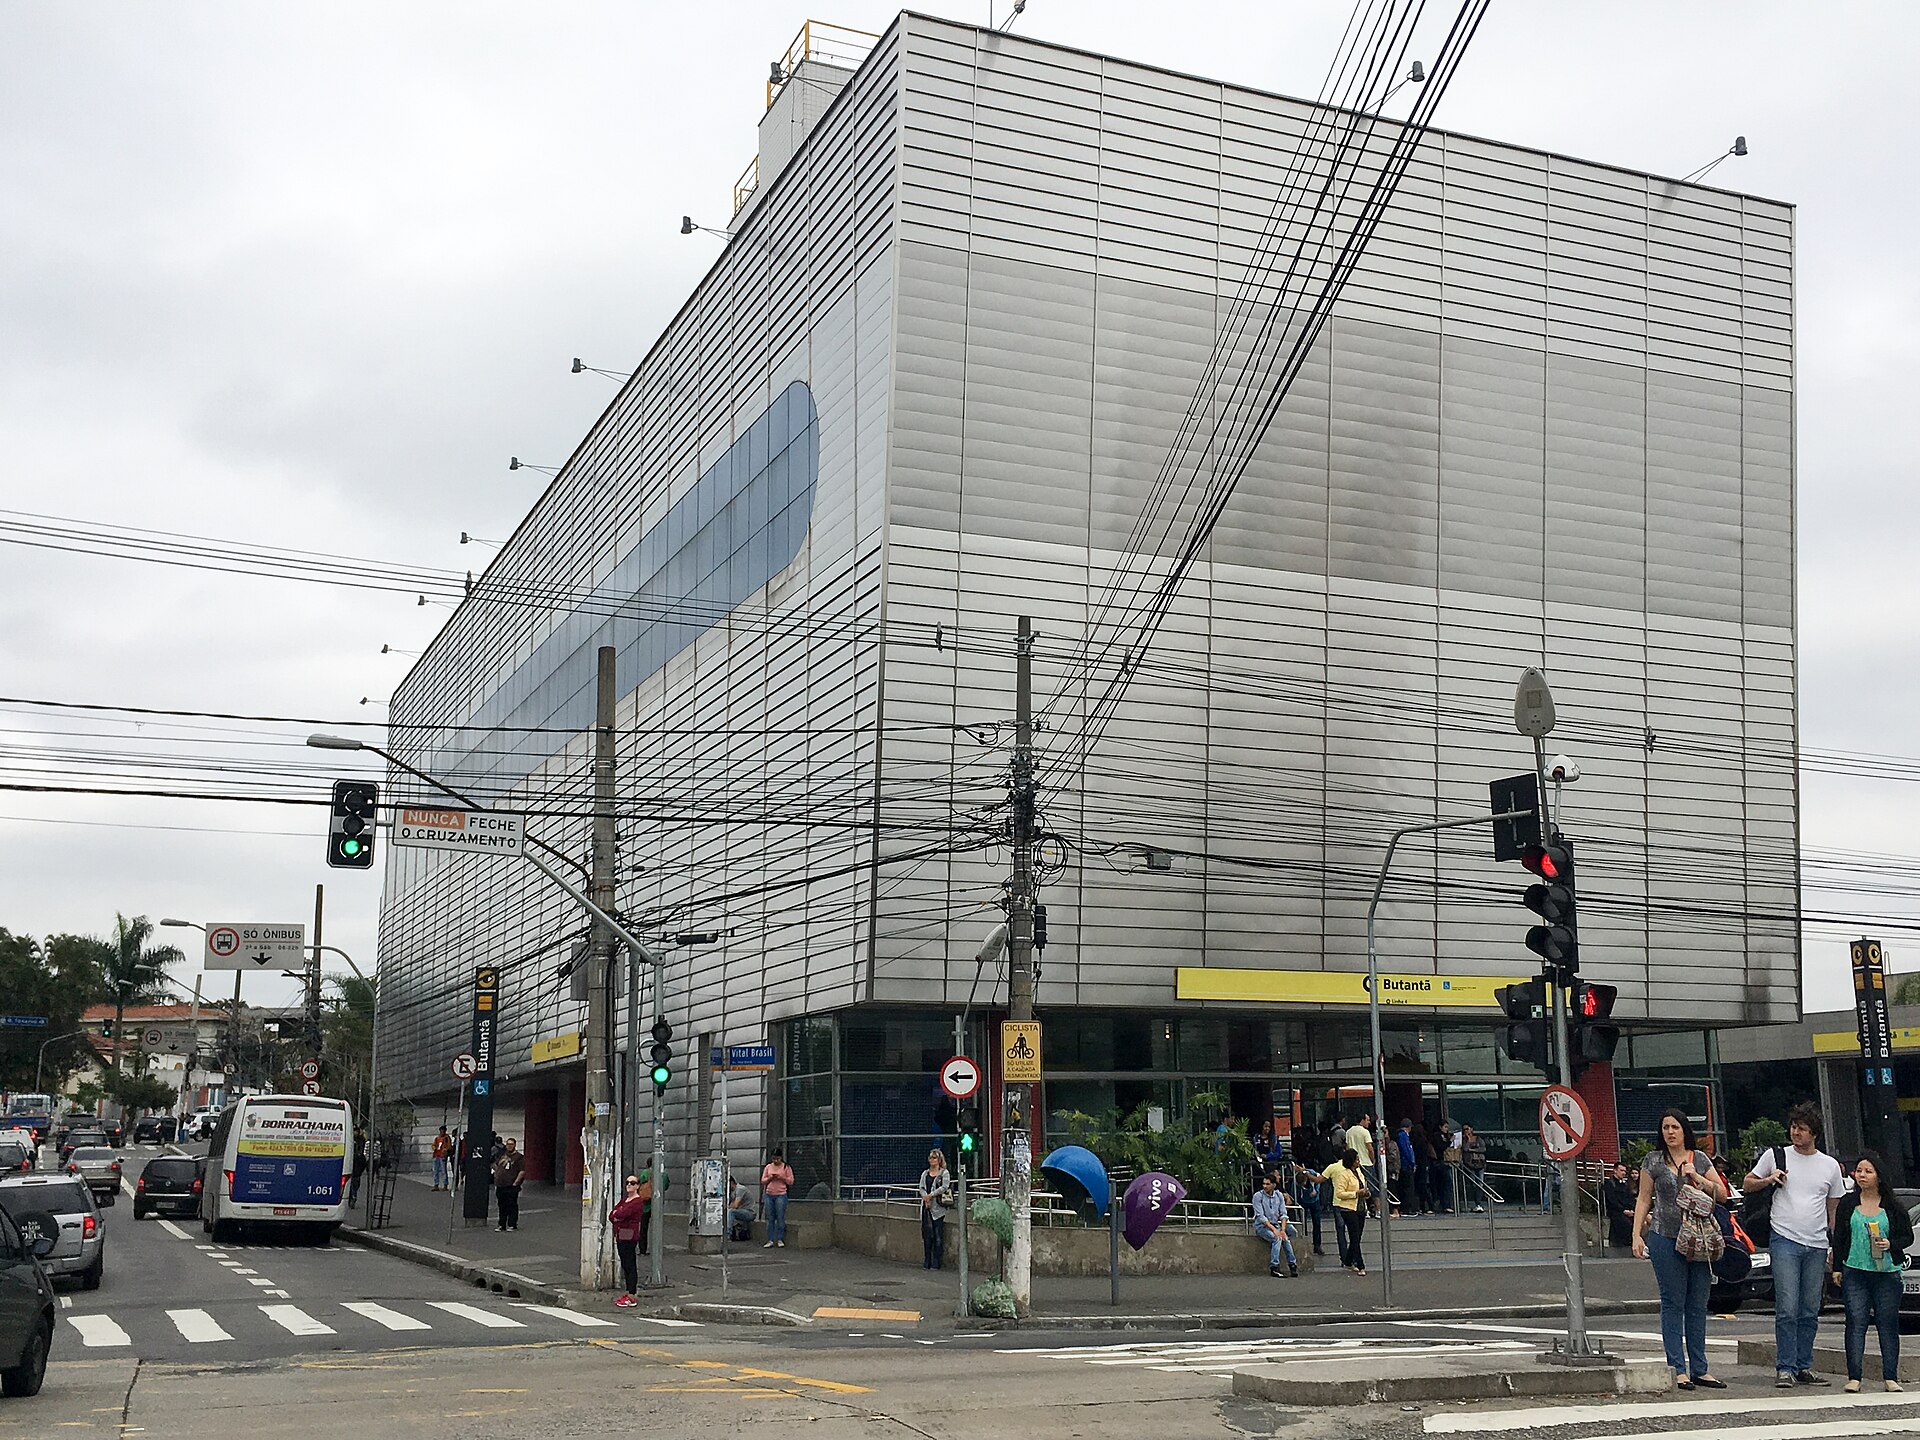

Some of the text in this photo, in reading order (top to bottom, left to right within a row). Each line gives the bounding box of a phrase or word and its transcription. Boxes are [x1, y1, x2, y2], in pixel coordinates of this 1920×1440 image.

[408, 810, 517, 832] NUNCA FECHE
[401, 827, 517, 849] O CRUZAMENTO
[243, 928, 301, 939] SÓ ÔNIBUS
[1383, 979, 1431, 991] Butantã
[1004, 1024, 1039, 1032] CICLISTA
[1875, 1000, 1889, 1058] Butantã
[477, 1019, 490, 1071] Butantã
[731, 1048, 749, 1058] Vital
[751, 1047, 773, 1058] Brasil
[304, 1065, 317, 1073] 40
[261, 1120, 344, 1131] BORRACHARIA
[307, 1186, 333, 1196] 1.061
[1148, 1180, 1162, 1211] vivo
